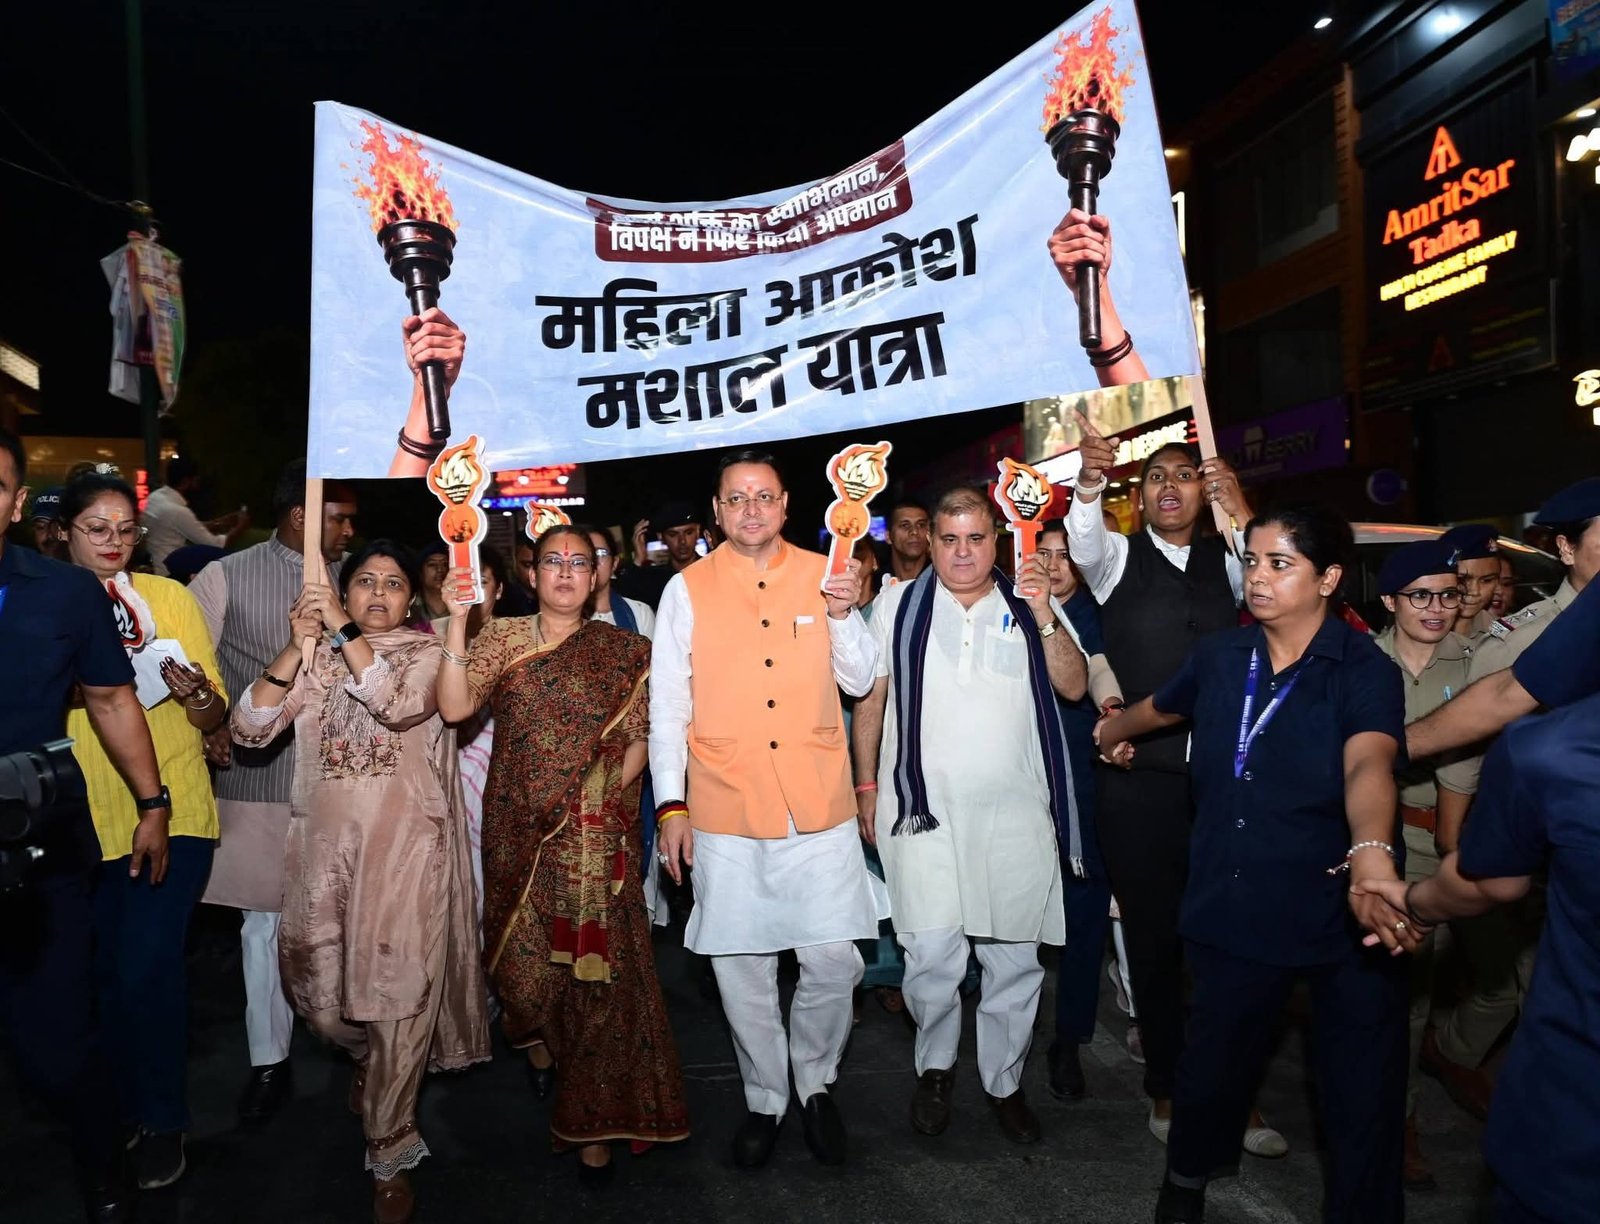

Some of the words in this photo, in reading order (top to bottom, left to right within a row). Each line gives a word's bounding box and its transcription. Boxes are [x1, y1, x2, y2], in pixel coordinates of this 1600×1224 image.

[608, 222, 673, 252] विपक्ष
[815, 186, 899, 236] अपमान
[1382, 159, 1516, 245] AmritSar
[1408, 218, 1481, 264] Tadka
[1466, 230, 1518, 266] FAMILY
[534, 277, 748, 354] महिला
[576, 343, 789, 430] मशाल
[797, 311, 948, 396] यात्रा
